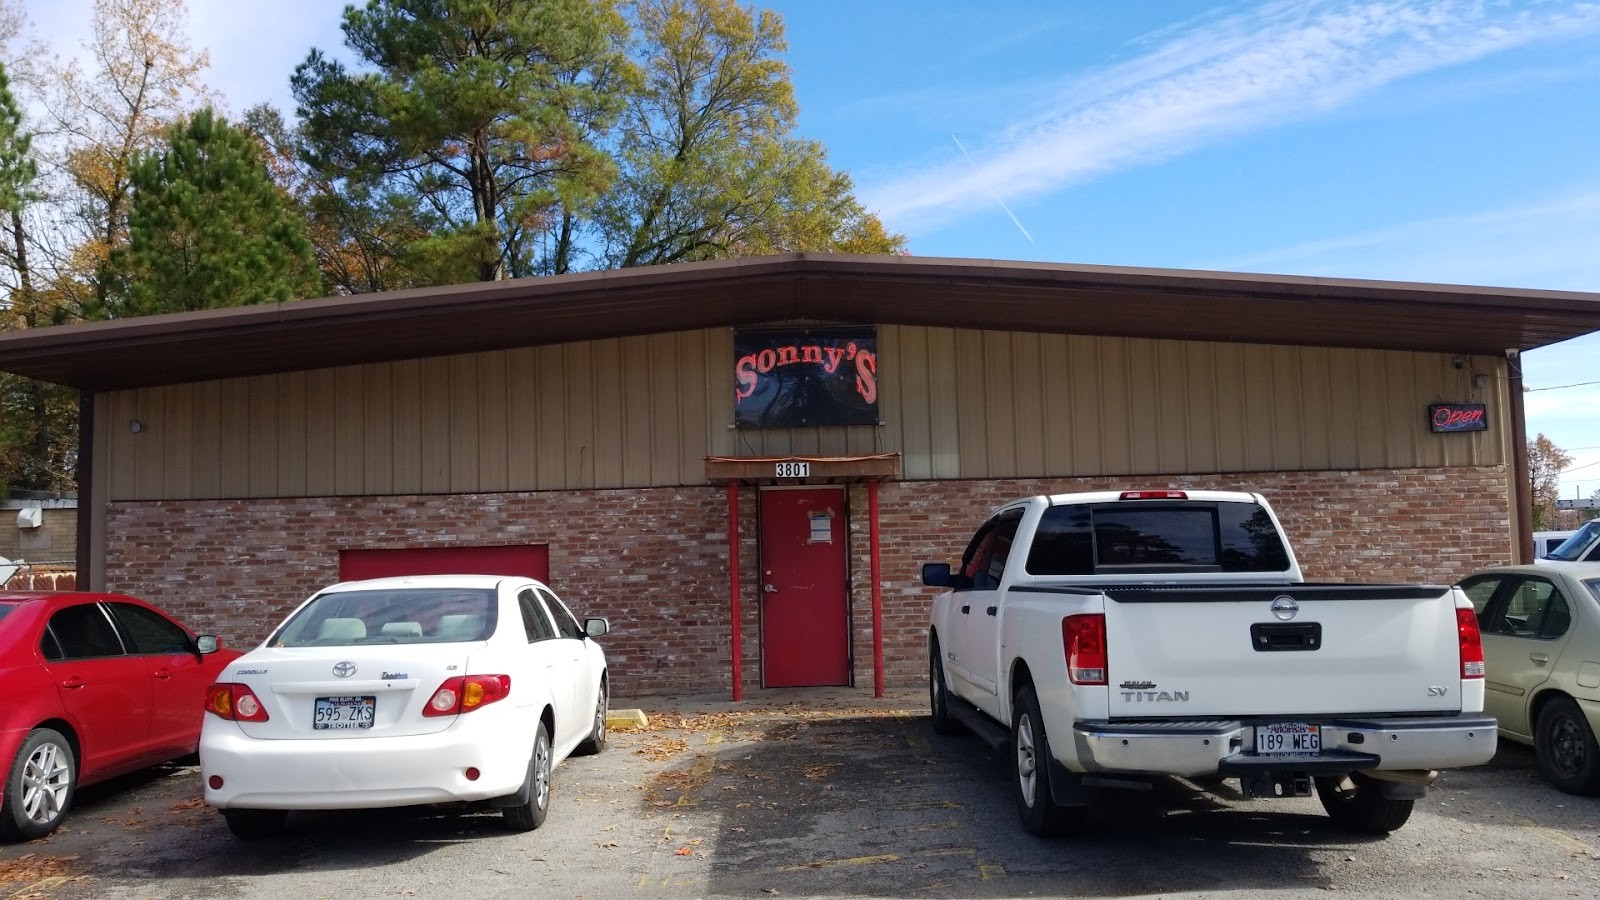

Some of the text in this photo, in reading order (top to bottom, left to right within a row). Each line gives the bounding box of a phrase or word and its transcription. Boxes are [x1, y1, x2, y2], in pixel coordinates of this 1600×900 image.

[1434, 408, 1483, 426] Open
[777, 463, 808, 477] 3801
[1121, 691, 1189, 702] TITAN
[1428, 686, 1448, 697] SV
[317, 706, 373, 722] 595 ZKS
[1260, 733, 1319, 750] 189 WEG
